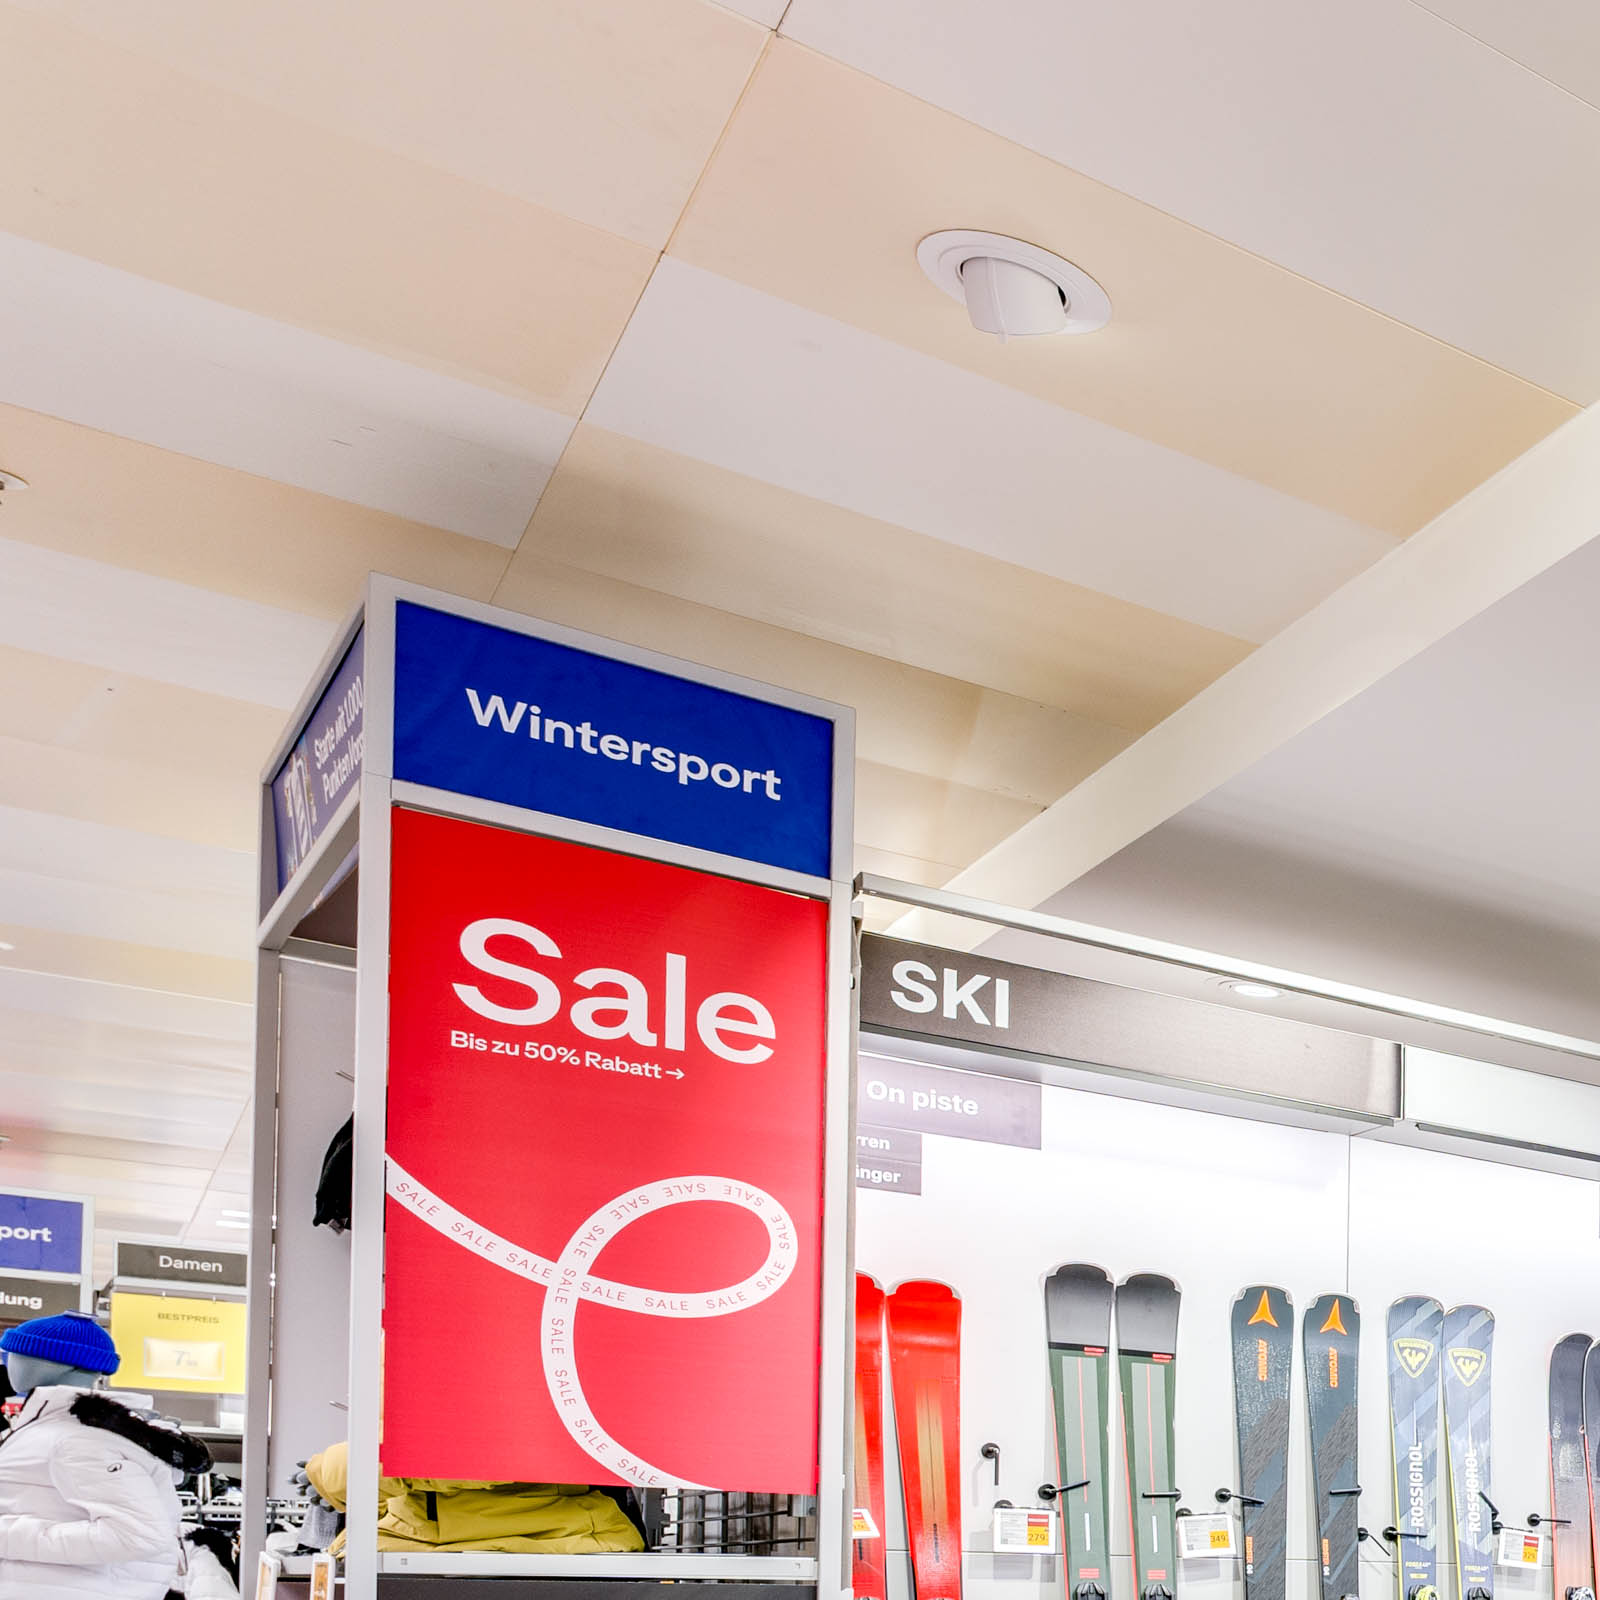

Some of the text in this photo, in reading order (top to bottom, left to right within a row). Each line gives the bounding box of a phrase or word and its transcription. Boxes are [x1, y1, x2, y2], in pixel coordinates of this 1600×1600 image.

[314, 721, 336, 770] Starte
[334, 704, 347, 744] mit
[466, 688, 781, 800] Wintersport
[322, 746, 351, 804] Punkten
[452, 918, 776, 1064] Sale
[890, 960, 1010, 1029] SKI
[451, 1030, 662, 1079] Bis zu 50% Rabatt
[867, 1080, 979, 1116] On piste
[396, 1182, 440, 1217] SALE
[610, 1194, 650, 1220] SALE
[663, 1182, 706, 1198] SALE
[723, 1184, 765, 1207] SALE
[451, 1222, 497, 1252] SALE
[573, 1224, 605, 1259] SALE
[771, 1214, 790, 1250] SALE
[159, 1255, 223, 1273] Damen
[506, 1252, 553, 1279] SALE
[756, 1260, 786, 1291] SALE
[554, 1268, 576, 1305] SALE
[581, 1282, 628, 1302] SALE
[644, 1297, 689, 1311] SALE
[706, 1291, 747, 1310] SALE
[158, 1312, 220, 1324] BESTPREIS
[551, 1317, 564, 1355] SALE
[1258, 1339, 1268, 1381] ATOMIC
[1329, 1347, 1339, 1388] ATOMIC
[555, 1369, 577, 1406] SALE
[575, 1419, 609, 1454] SALE
[617, 1458, 660, 1486] SALE
[1409, 1440, 1425, 1528] ROSSIGNOL
[1465, 1447, 1481, 1533] ROSSIGNOL
